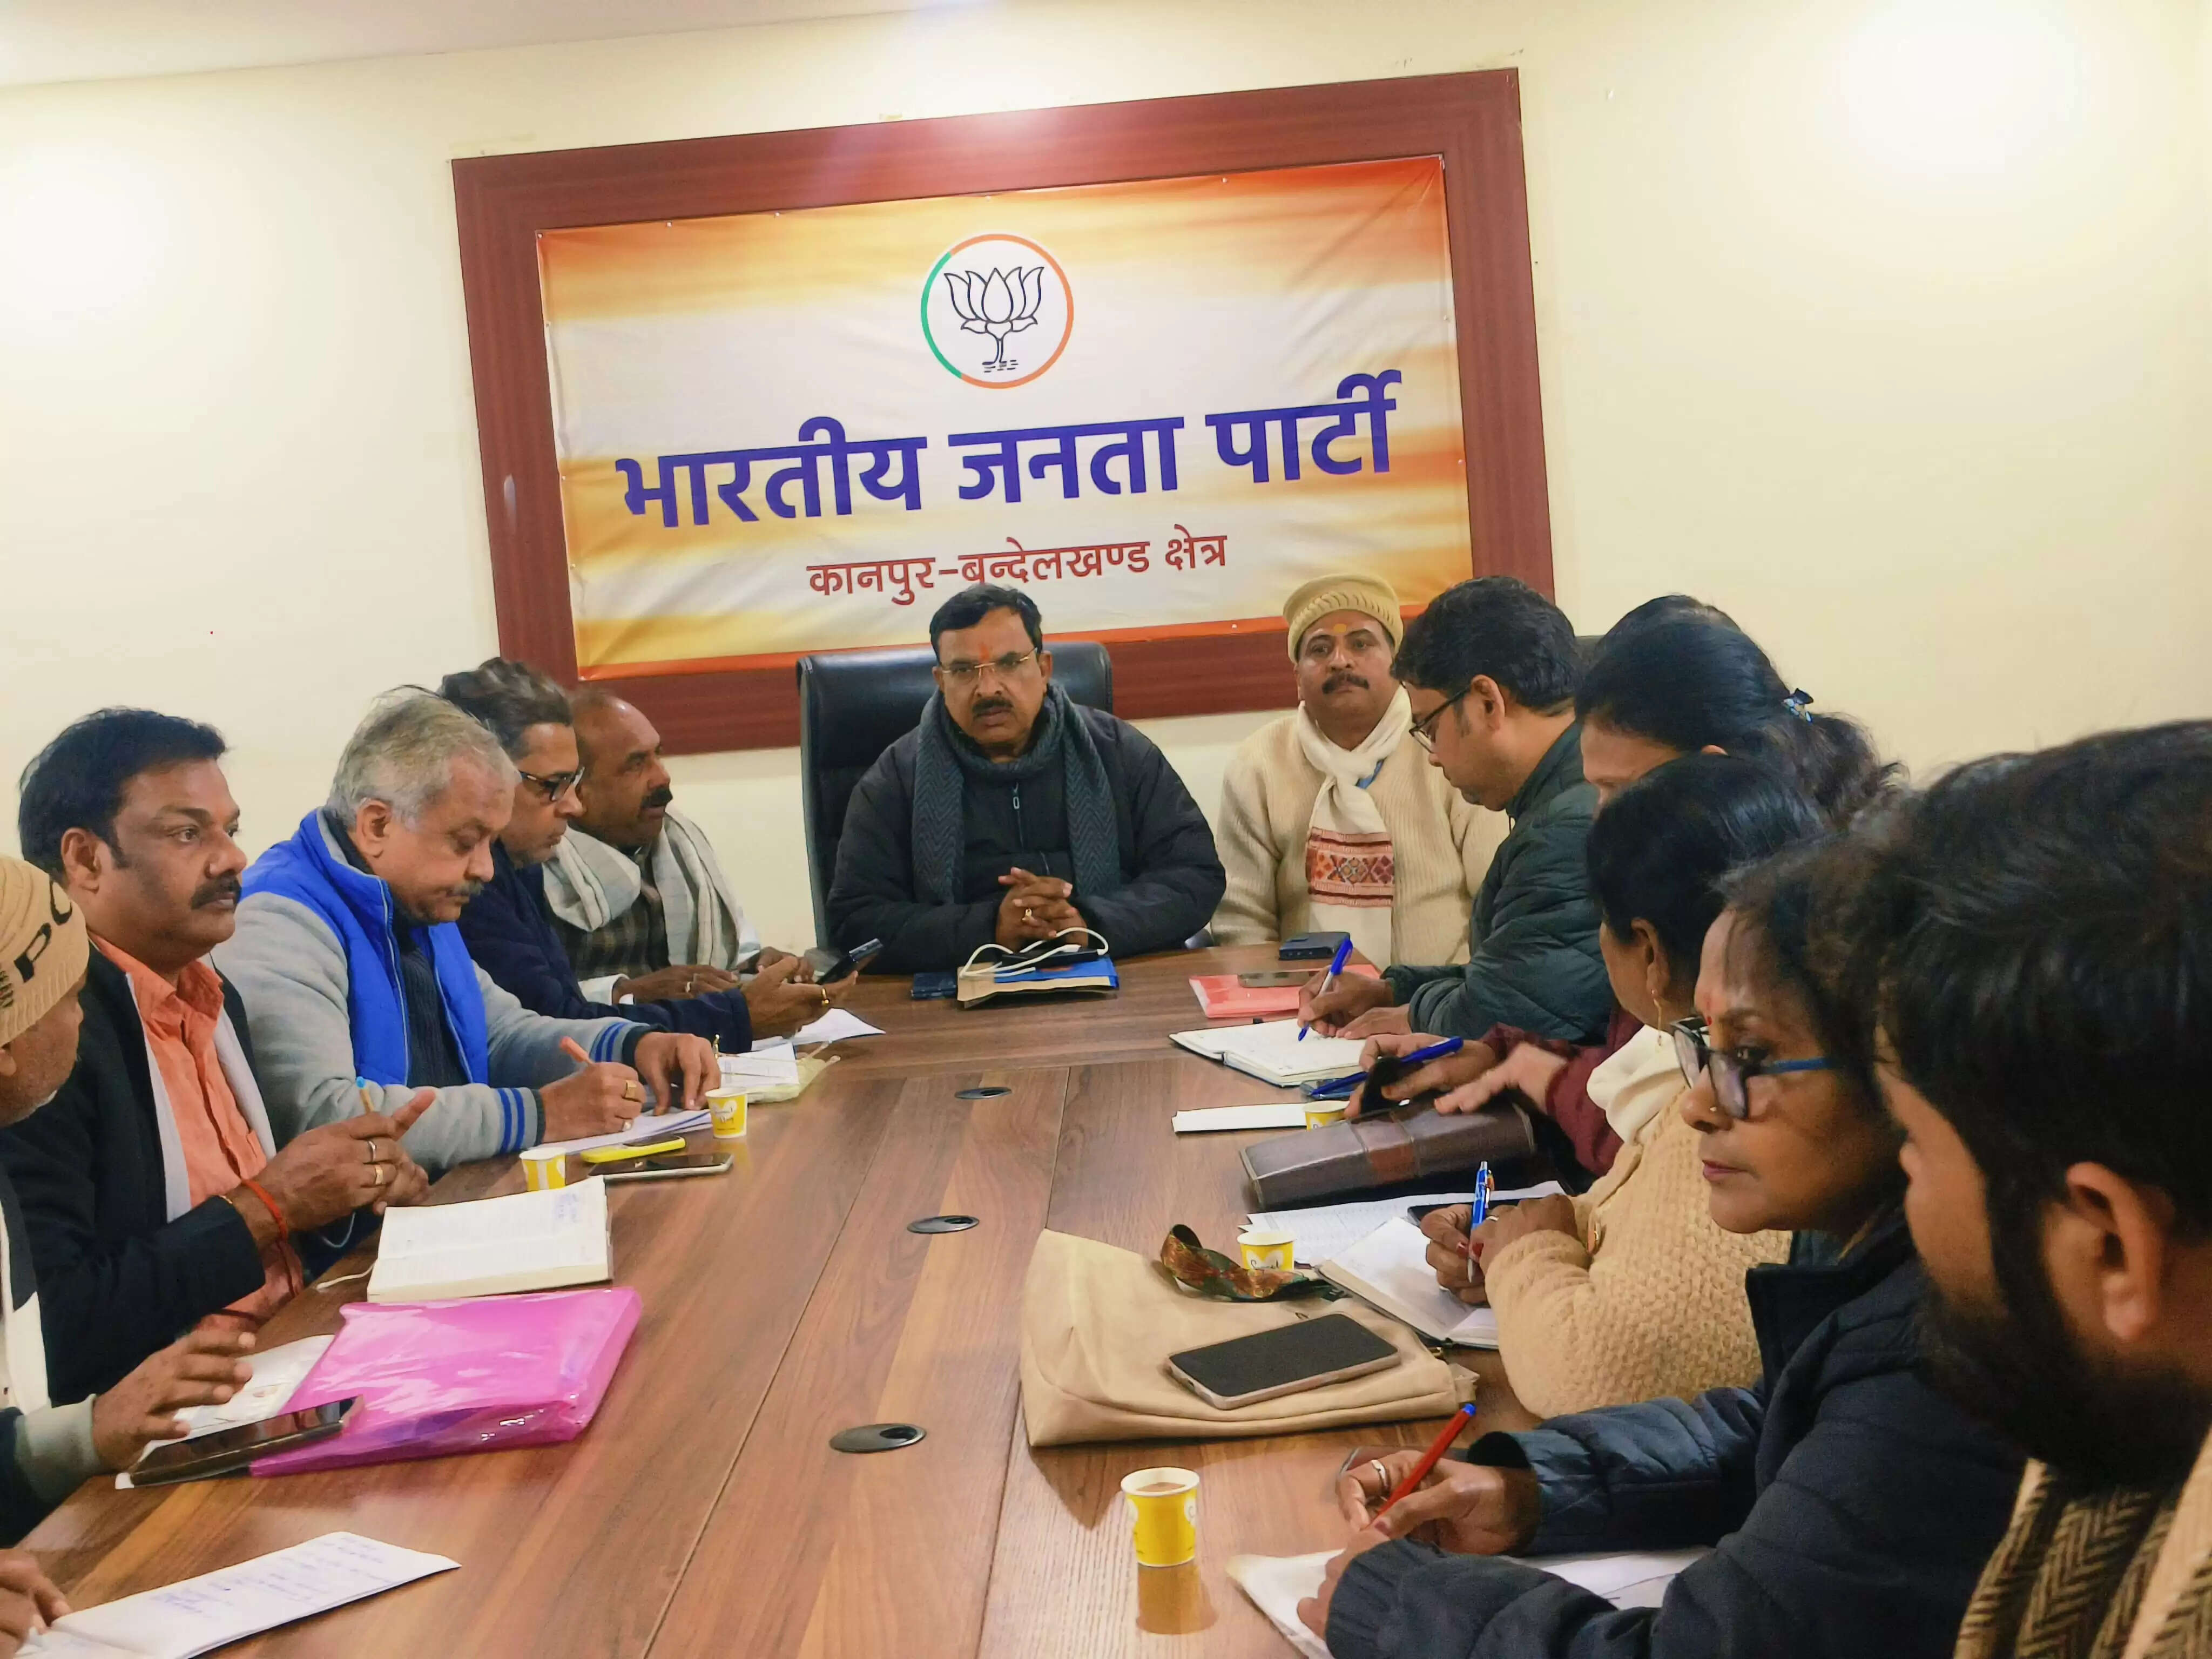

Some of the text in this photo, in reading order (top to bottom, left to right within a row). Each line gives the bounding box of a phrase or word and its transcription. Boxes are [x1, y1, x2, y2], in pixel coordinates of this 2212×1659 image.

[615, 369, 1402, 528] भारतीय जनता पार्टी
[806, 524, 1228, 606] कानपुर-बन्देलखण्ड क्षेत्र
